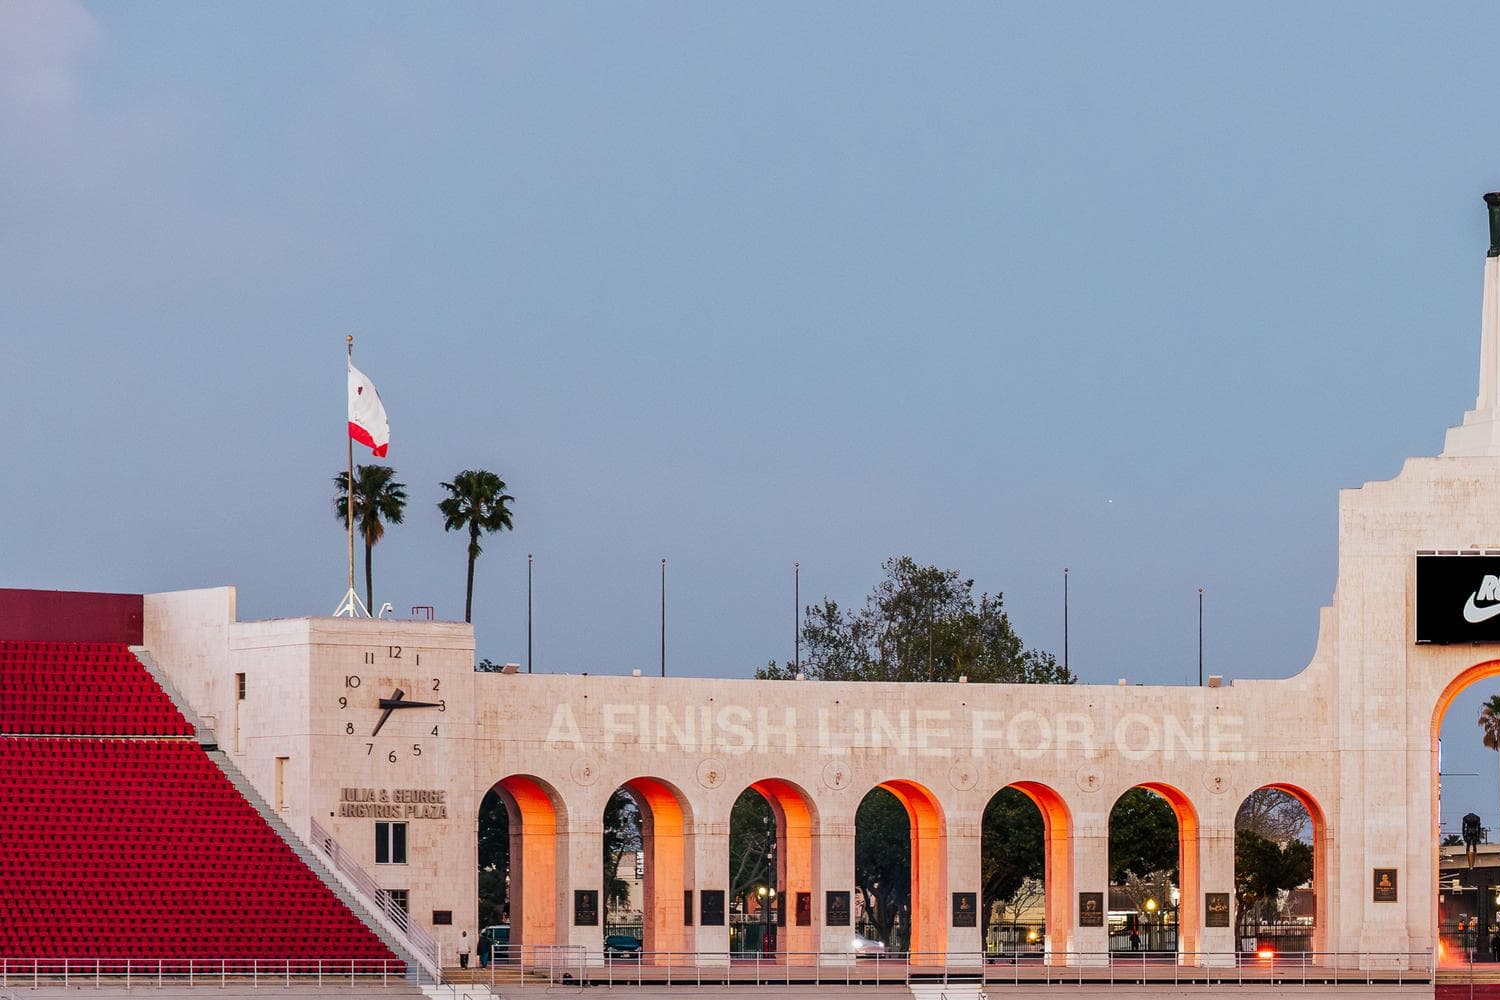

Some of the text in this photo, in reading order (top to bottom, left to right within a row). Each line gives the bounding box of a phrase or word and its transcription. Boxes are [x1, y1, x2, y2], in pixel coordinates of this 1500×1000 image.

[365, 652, 374, 664] 11
[389, 646, 402, 659] 12
[415, 654, 420, 666] 1
[345, 675, 361, 688] 10
[432, 678, 441, 691] 2
[338, 696, 347, 709] 9
[438, 699, 446, 712] 3
[346, 722, 355, 735] 8
[431, 724, 439, 736] 4
[543, 702, 1258, 762] A FINISH LINE FOR ONE.
[365, 743, 374, 755] 7
[412, 743, 422, 756] 5
[388, 750, 397, 763] 6
[339, 787, 448, 804] JULIA & GEORGE
[338, 803, 448, 820] ARGYROS PLAZA
